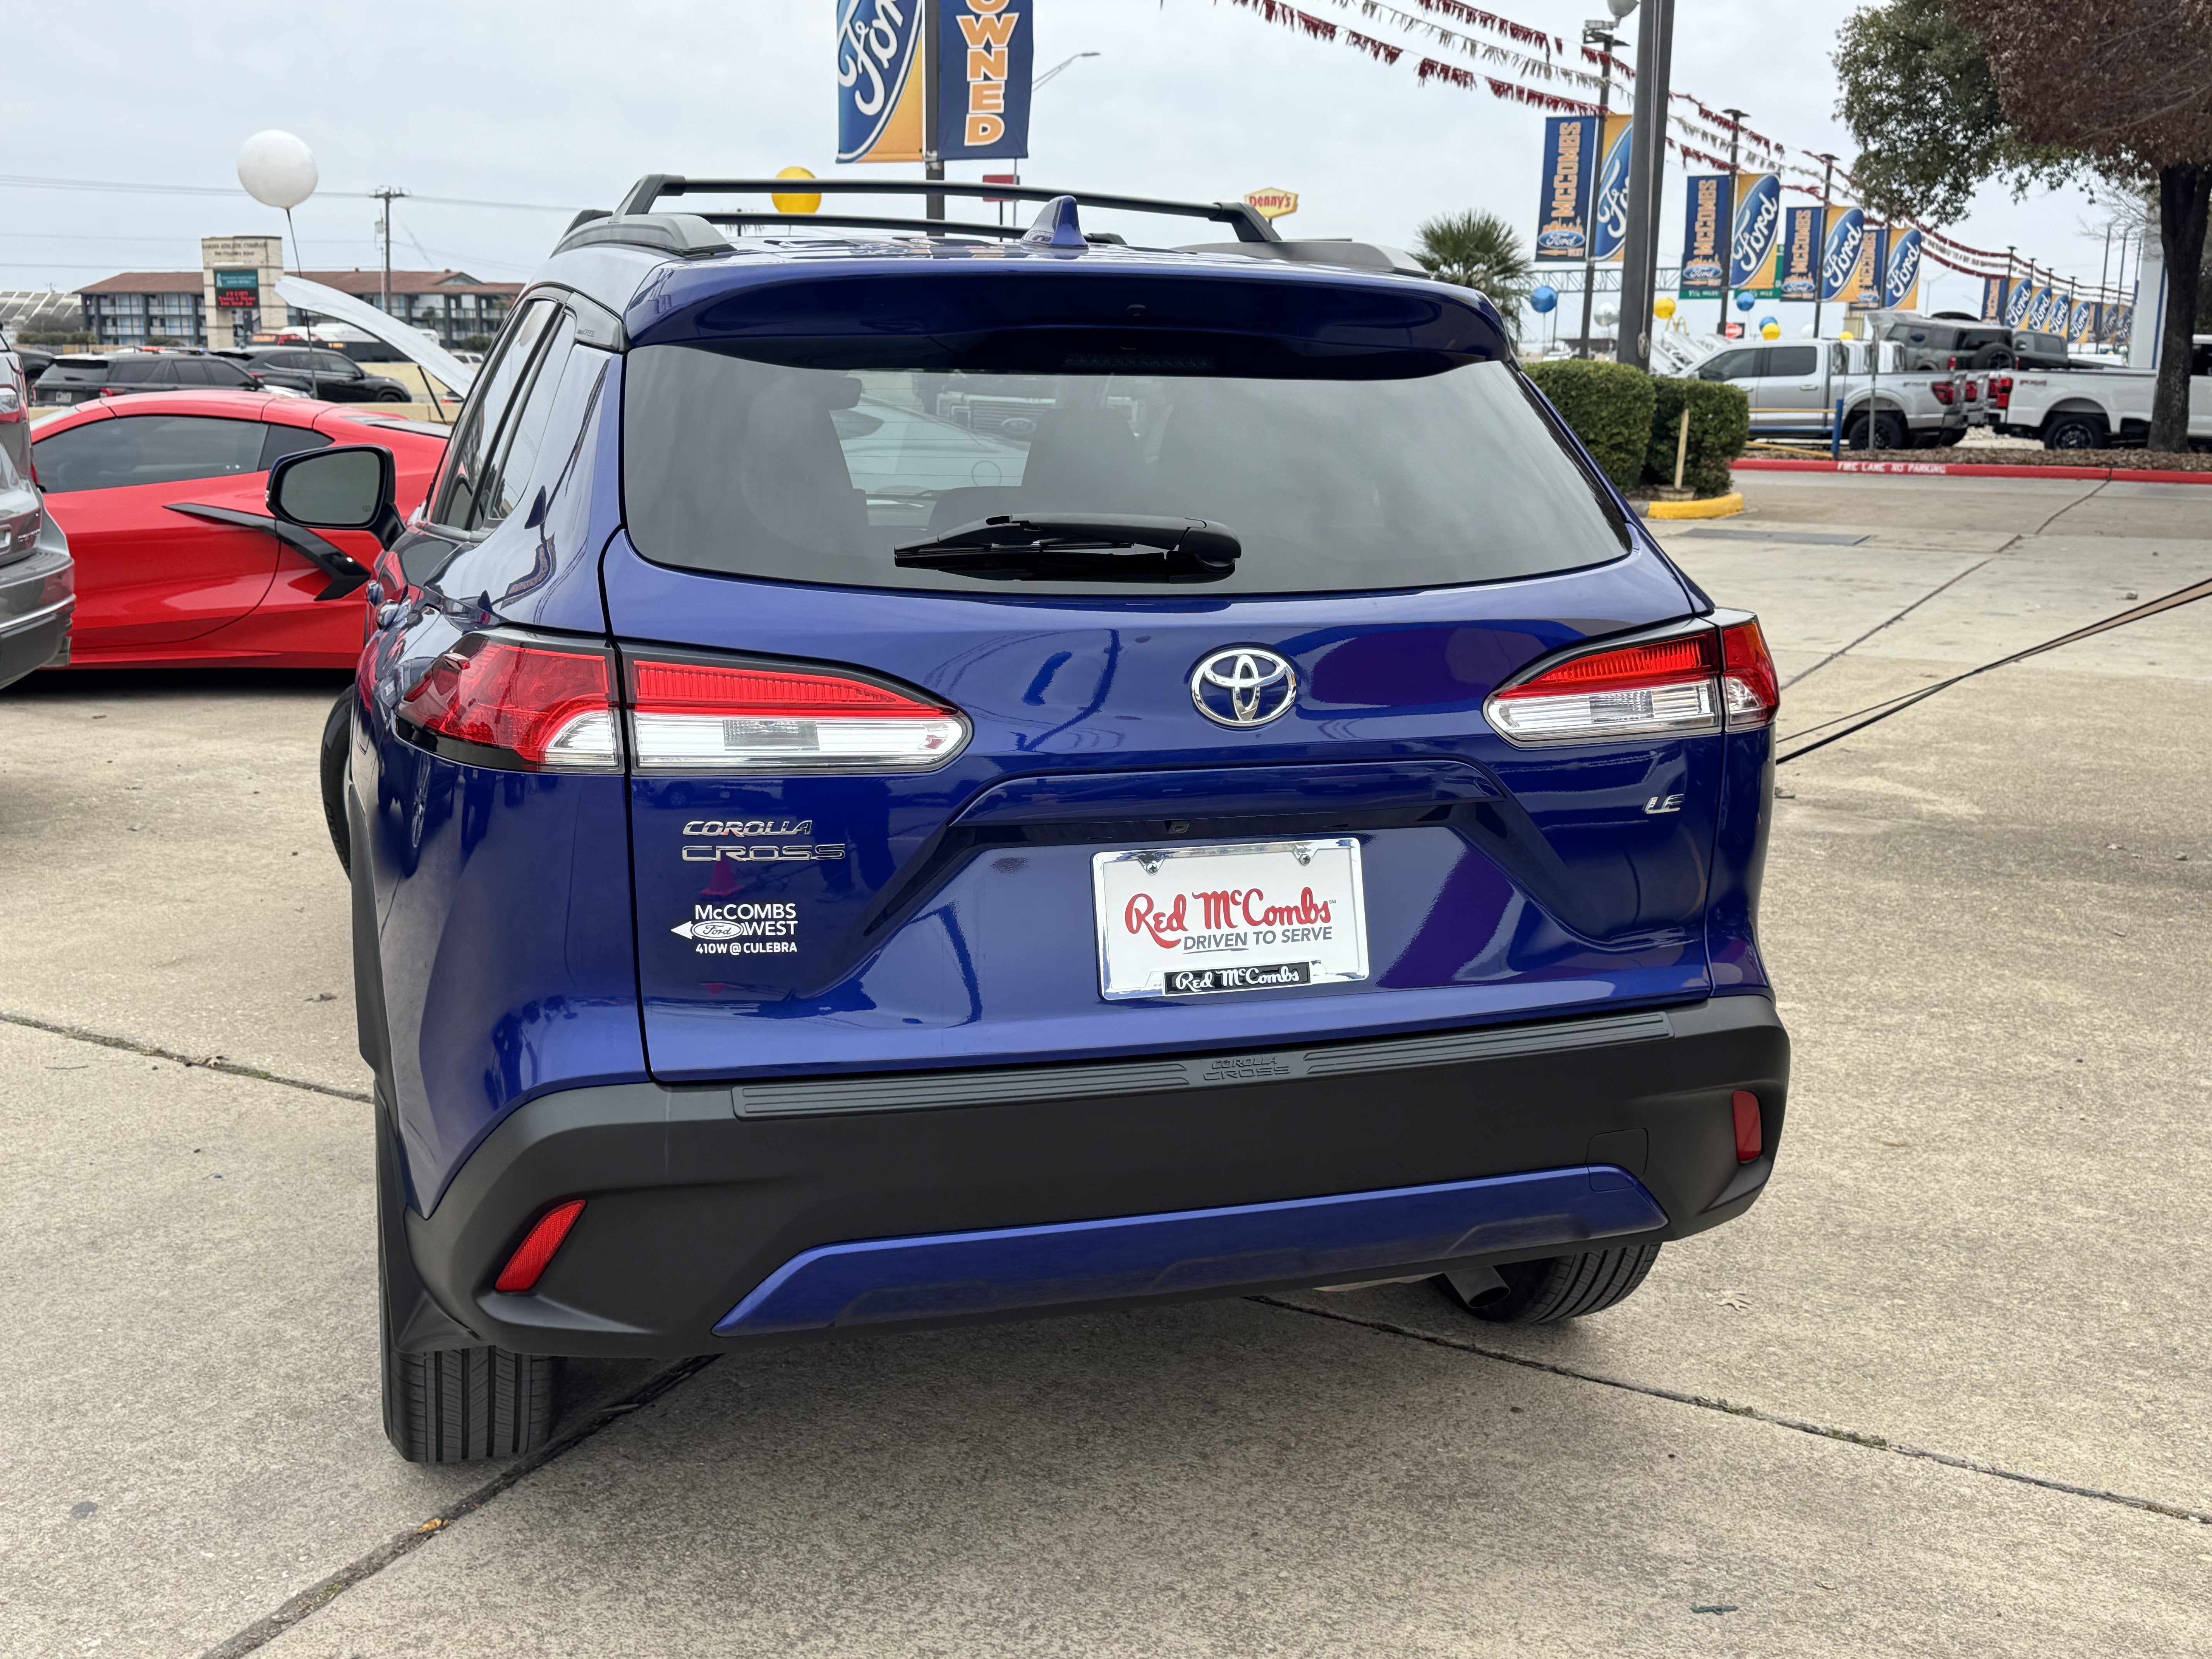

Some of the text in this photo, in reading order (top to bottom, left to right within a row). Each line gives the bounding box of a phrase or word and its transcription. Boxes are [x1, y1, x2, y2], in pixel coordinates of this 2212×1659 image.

[1249, 194, 1291, 209] Denny's
[1732, 192, 1778, 271] Ford
[1822, 222, 1862, 288] Ford
[1886, 241, 1920, 297] Ford
[2006, 285, 2031, 326] Ford
[2030, 294, 2051, 330] Ford
[1908, 463, 1946, 474] PARKING
[1644, 794, 1684, 814] LE
[682, 820, 812, 837] COROLLA
[682, 843, 845, 861] CROSS
[695, 903, 796, 920] McCOMBS
[1125, 893, 1188, 949] Red
[1192, 887, 1331, 929] McCombs
[702, 921, 798, 936] Ford WEST
[1183, 926, 1332, 950] DRIVEN TO SERVE
[696, 942, 798, 955] 410W @ CULEBRA
[1175, 966, 1299, 992] Red McCombs
[1212, 1057, 1278, 1069] COROLLA
[1203, 1066, 1290, 1080] CROSS
